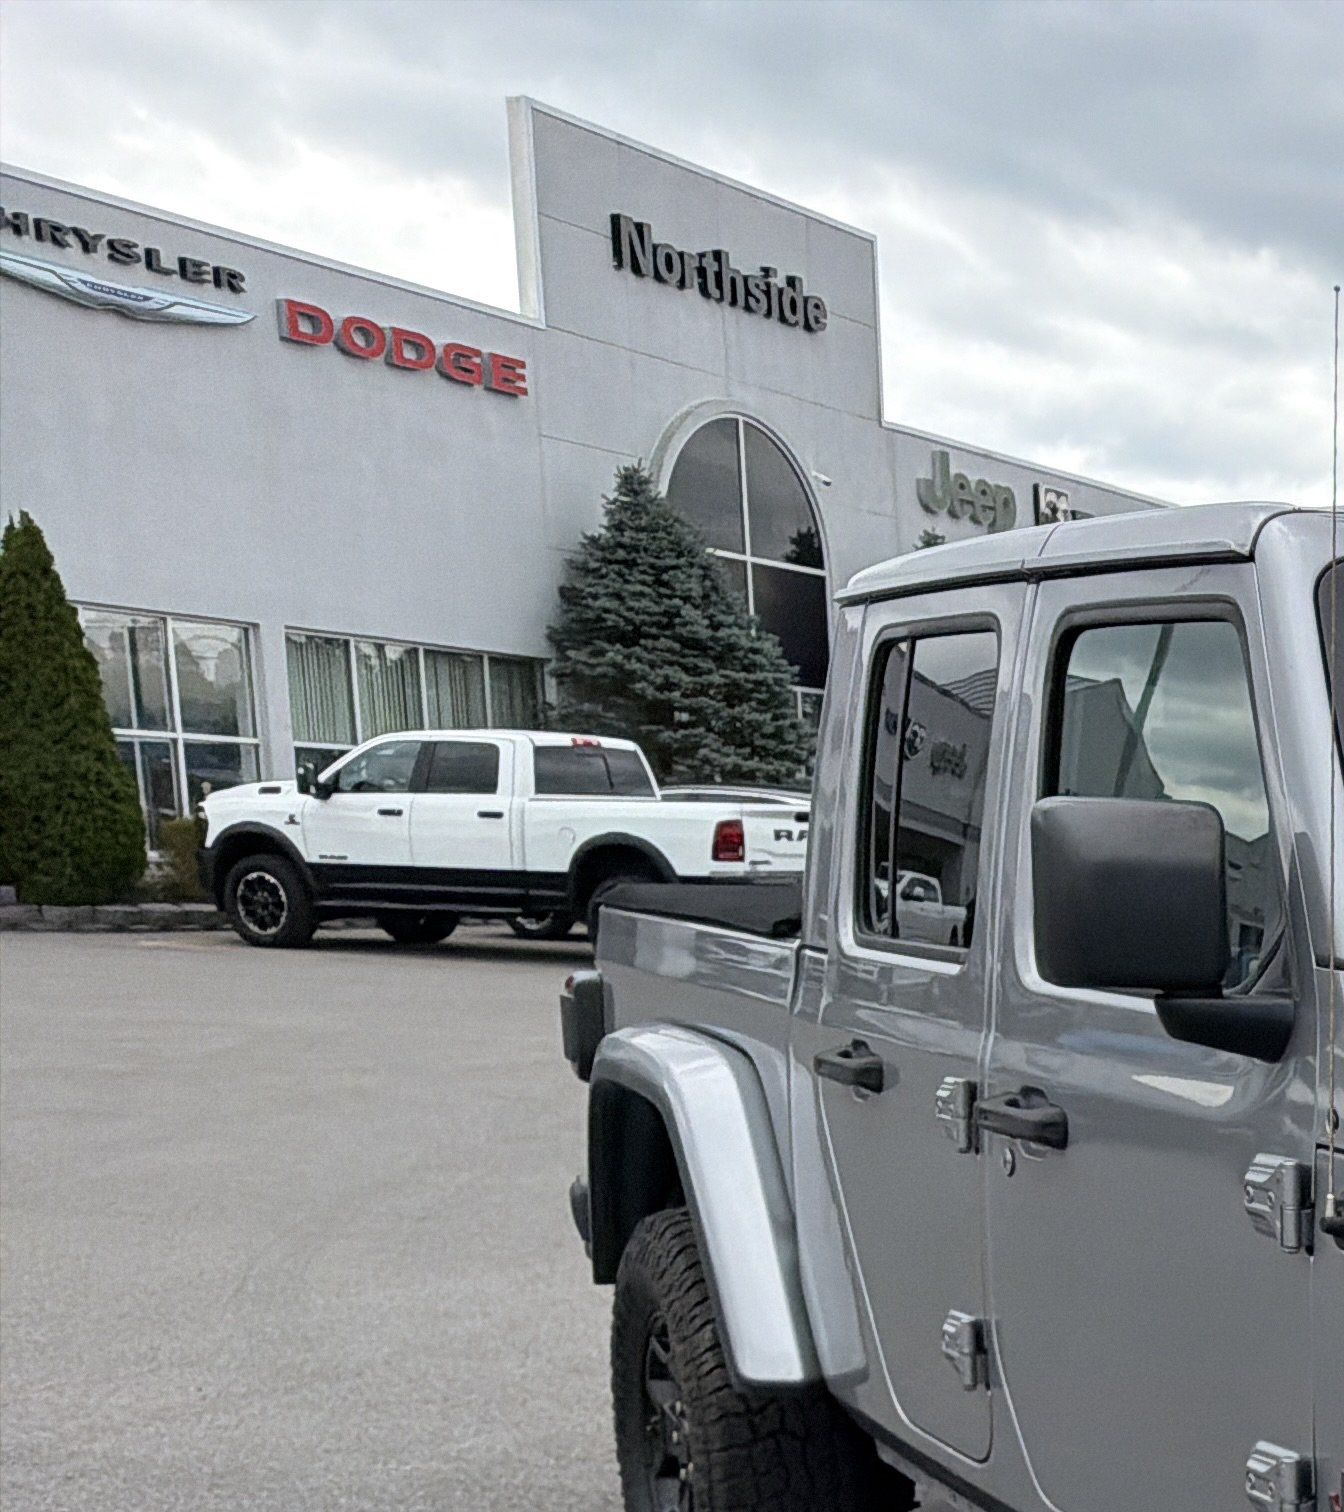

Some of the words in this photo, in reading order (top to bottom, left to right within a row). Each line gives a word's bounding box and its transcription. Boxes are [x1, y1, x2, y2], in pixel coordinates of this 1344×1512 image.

[0, 206, 247, 295] HRYSLER
[609, 212, 829, 334] Northside
[278, 297, 529, 397] DODGE
[915, 449, 1017, 534] Jeep
[773, 829, 809, 842] RA
